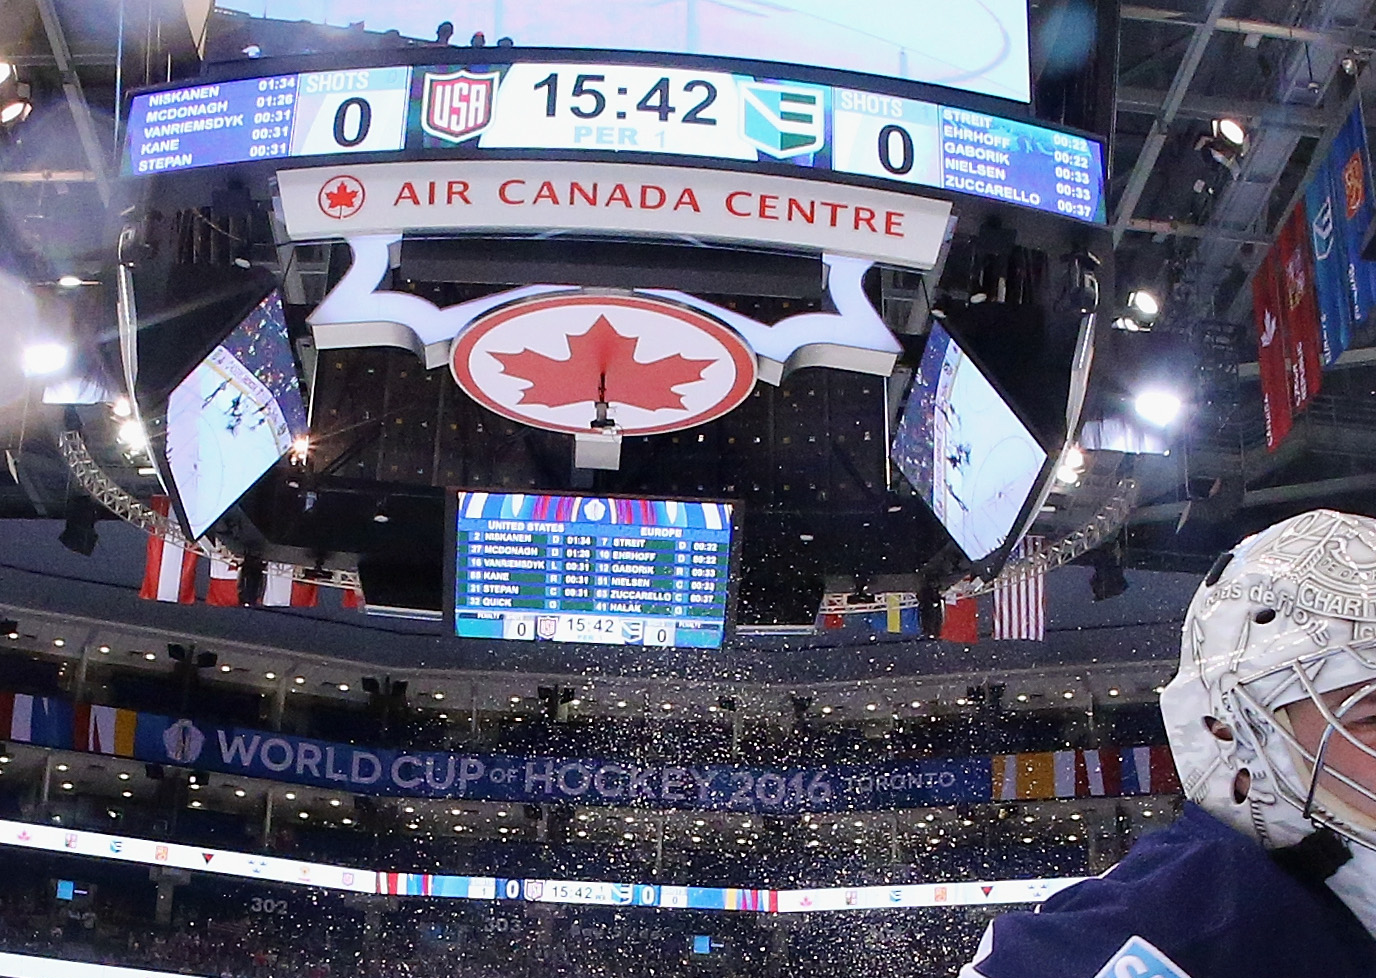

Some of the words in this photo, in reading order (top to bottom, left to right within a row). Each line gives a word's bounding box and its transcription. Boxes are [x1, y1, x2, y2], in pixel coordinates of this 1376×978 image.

[149, 86, 220, 107] NISKANEN
[258, 78, 295, 91] 01:34
[306, 71, 369, 93] SHOTS
[146, 101, 228, 123] MCDONAGH
[256, 93, 293, 108] 01:26
[433, 81, 486, 132] USA
[533, 72, 718, 126] 15:42
[841, 91, 903, 117] SHOTS
[144, 114, 244, 139] VANRIEMSDYK
[254, 109, 291, 124] 00:31
[333, 97, 372, 147] 0
[943, 108, 994, 129] STREIT
[1053, 133, 1088, 152] 00:22
[140, 139, 180, 155] KANE
[252, 126, 289, 140] 00:31
[574, 126, 639, 145] PER
[655, 130, 665, 148] 1
[943, 125, 1011, 149] EHRHOFF
[1054, 151, 1089, 169] 00:22
[138, 154, 192, 172] STEPAN
[250, 143, 286, 157] 00:31
[878, 124, 914, 175] 0
[944, 142, 1010, 166] GABORIK
[1055, 167, 1090, 185] 00:33
[944, 158, 1006, 181] NIELSEN
[1056, 183, 1091, 201] 00:33
[944, 174, 1041, 205] ZUCCARELLO
[1057, 199, 1092, 217] 00:37
[393, 180, 472, 207] AIR
[498, 179, 701, 213] CANADA
[725, 191, 906, 237] CENTRE
[484, 532, 532, 543] NISKANEN
[488, 520, 525, 531] UNITED
[526, 522, 565, 533] STATES
[640, 527, 683, 538] EUROPE
[613, 538, 646, 548] STREIT
[483, 571, 510, 581] KANE
[611, 577, 650, 587] NIELSEN
[483, 584, 519, 594] STEPAN
[610, 590, 671, 601] ZUCCARELLO
[482, 597, 512, 607] QUICK
[609, 603, 642, 613] HALAK
[517, 622, 526, 636] 0
[568, 618, 614, 633] 15:42
[657, 629, 667, 643] 0
[217, 729, 382, 785] WORLD
[391, 755, 484, 792] CUP
[489, 766, 518, 783] OF
[525, 760, 715, 801] HOCKEY
[732, 771, 833, 804] 2016
[844, 771, 956, 794] TORONTO
[506, 880, 519, 899] 0
[553, 886, 593, 899] 15:42
[642, 886, 655, 905] 0
